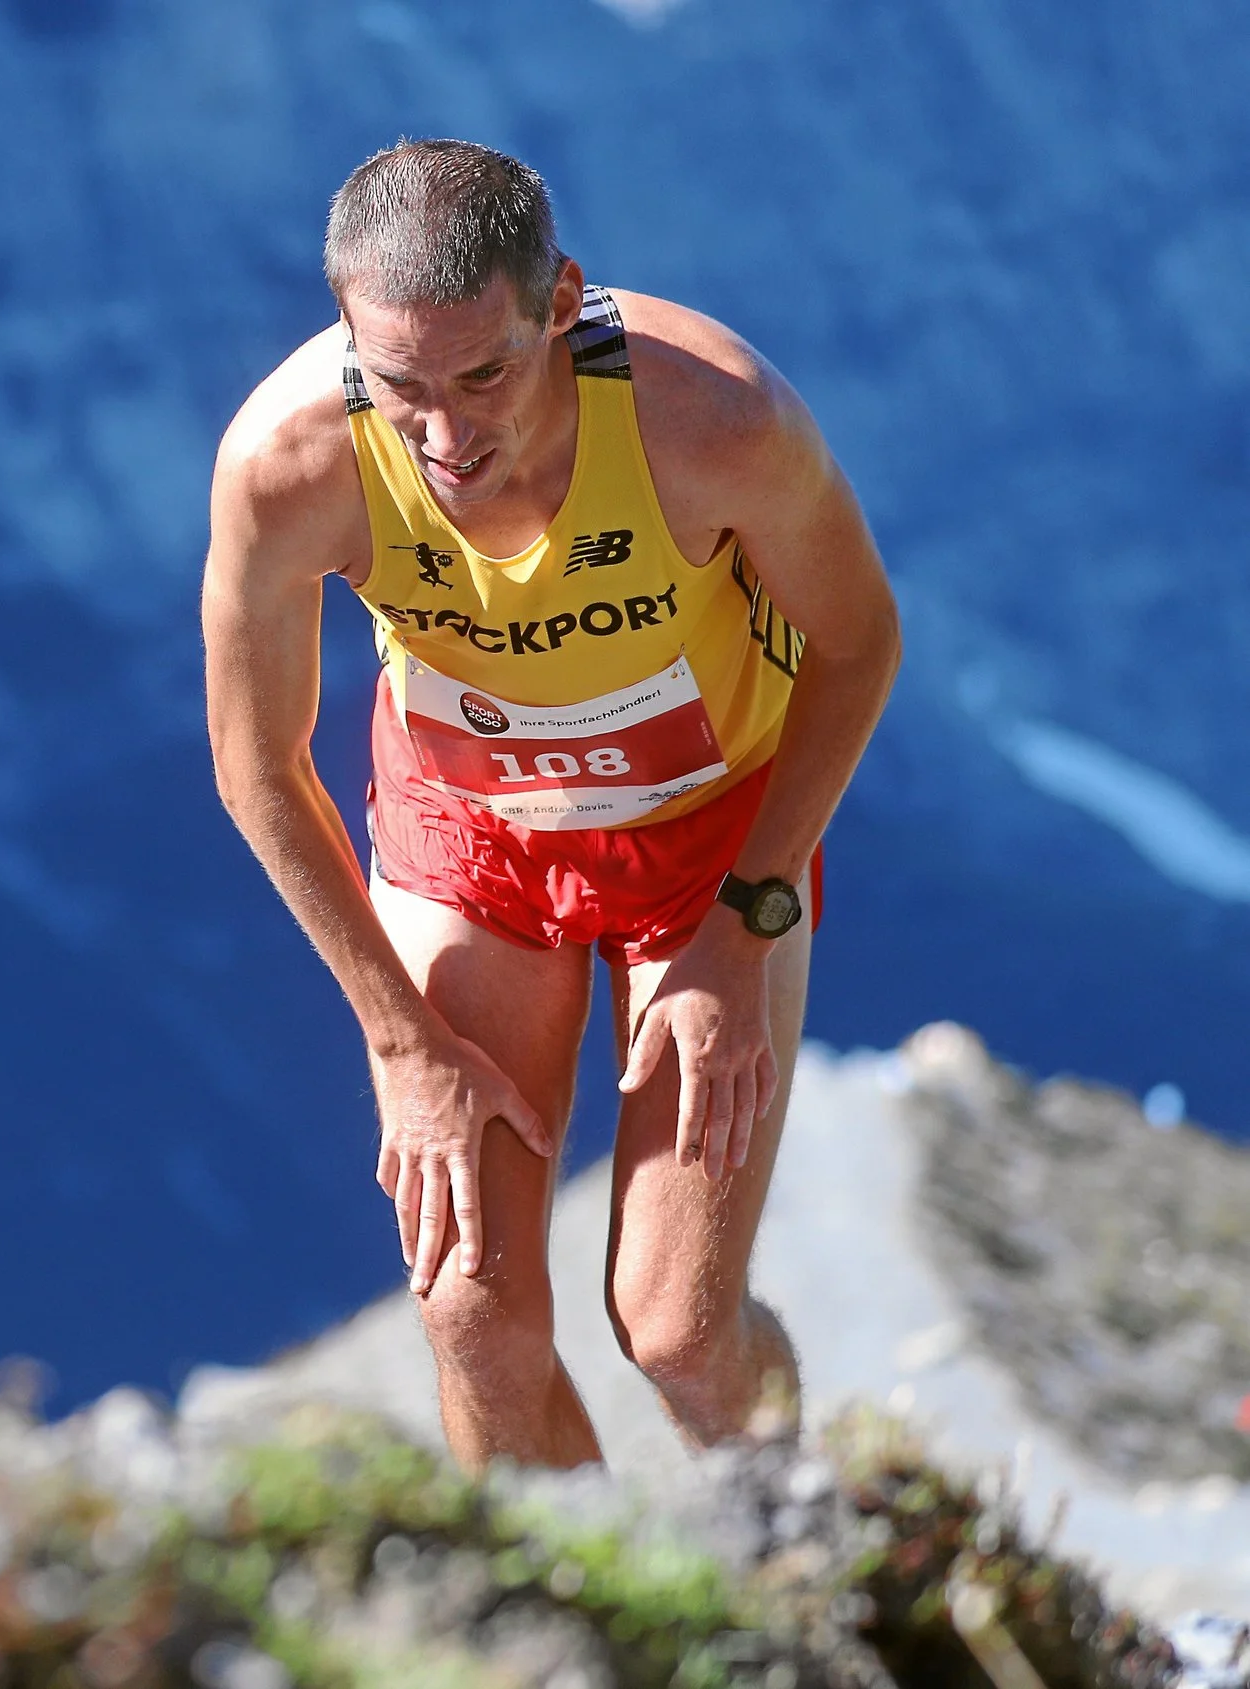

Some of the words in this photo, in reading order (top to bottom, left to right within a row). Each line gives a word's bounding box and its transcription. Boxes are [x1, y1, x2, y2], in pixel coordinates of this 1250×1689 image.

[379, 583, 676, 655] STOCKPORT
[463, 699, 502, 721] SPORT
[467, 709, 502, 728] 2000
[490, 748, 631, 783] 108
